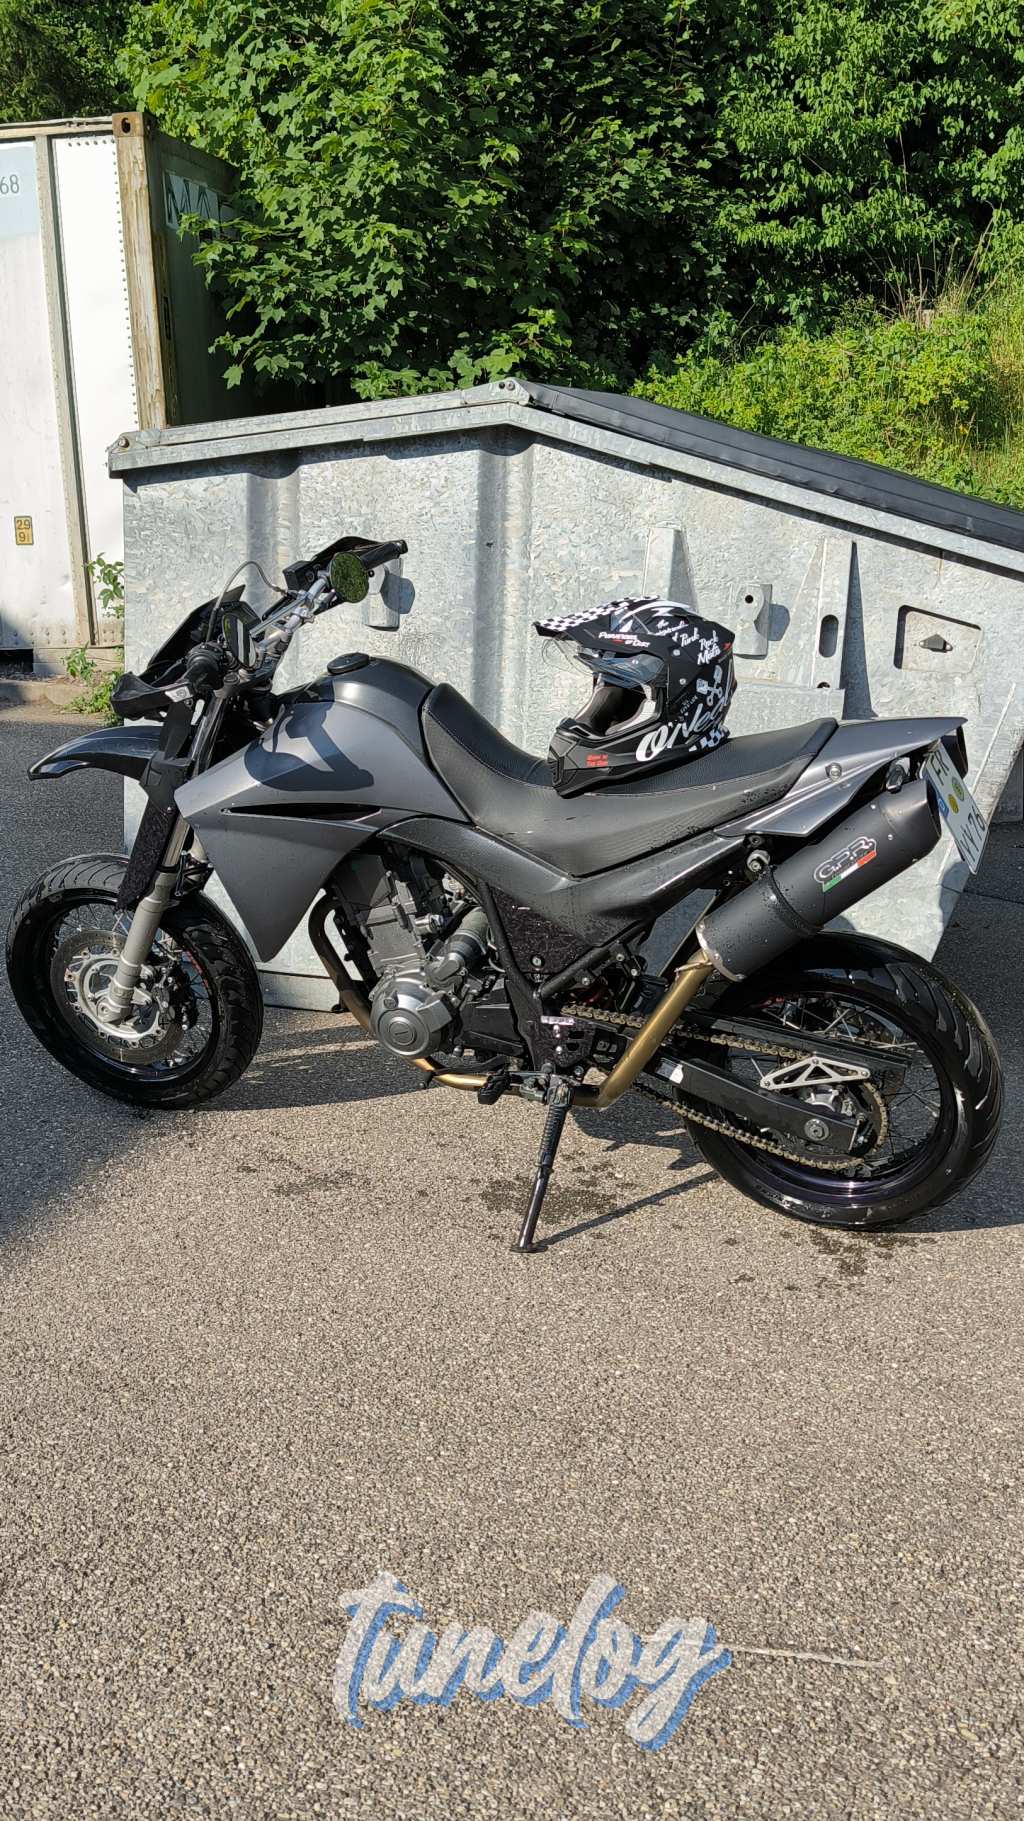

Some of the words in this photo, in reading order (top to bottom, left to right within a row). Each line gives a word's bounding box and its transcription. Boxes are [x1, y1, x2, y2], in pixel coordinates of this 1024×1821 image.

[680, 627, 700, 647] Punk
[699, 630, 719, 651] Rock
[930, 749, 950, 787] FR
